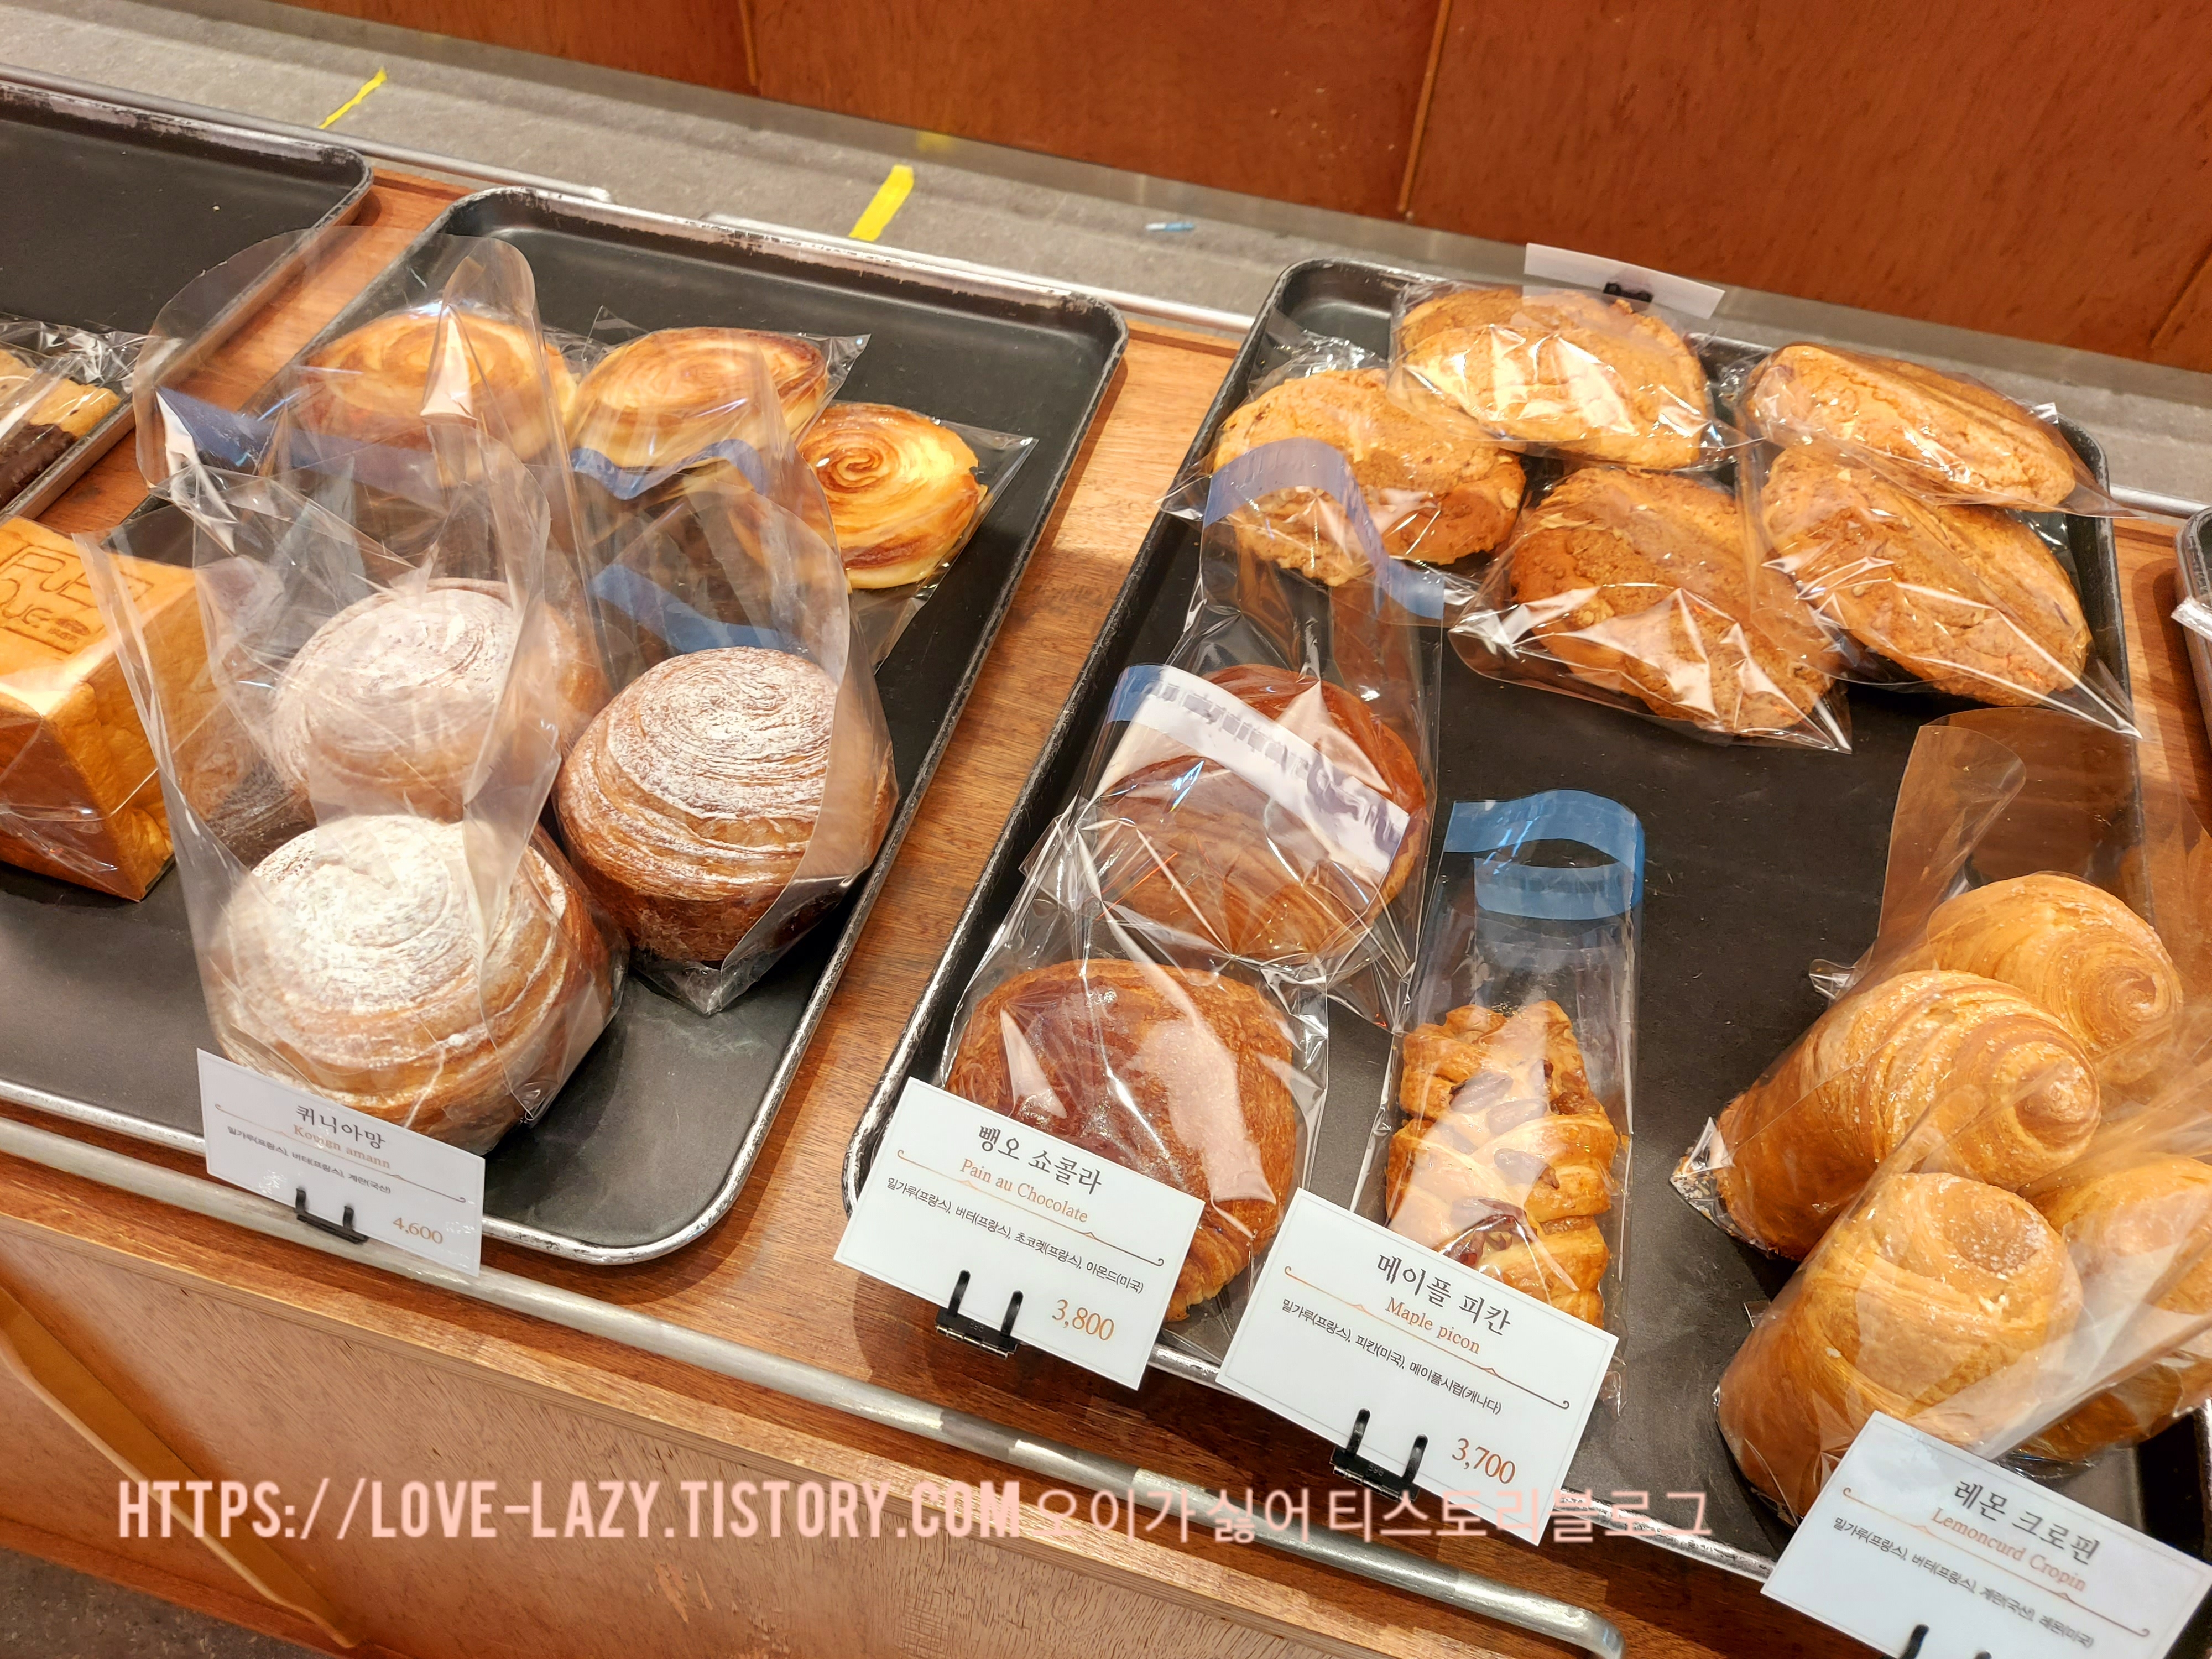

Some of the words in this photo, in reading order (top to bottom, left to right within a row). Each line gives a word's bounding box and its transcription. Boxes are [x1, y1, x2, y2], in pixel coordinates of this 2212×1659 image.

[296, 1105, 386, 1149] 퀴니아망
[346, 1147, 390, 1169] amann
[978, 1125, 1020, 1160] 뺑오
[1028, 1150, 1102, 1195] 쇼콜라
[960, 1158, 992, 1183] Pain
[995, 1177, 1013, 1192] au
[1018, 1183, 1088, 1223] Chocolate
[393, 1217, 444, 1245] 4,600
[1086, 1261, 1144, 1295] 아몬드(미국)
[1377, 1254, 1452, 1308] 메이플
[1459, 1295, 1511, 1335] 피칸
[1052, 1298, 1115, 1342] 3,800
[1385, 1297, 1433, 1330] Maple
[1436, 1326, 1480, 1354] picon
[1410, 1361, 1501, 1415] 메이플시럽(캐나다)
[1451, 1437, 1516, 1485] 3,700
[1931, 1507, 2027, 1561] Lemoncurd
[2030, 1554, 2086, 1592] Cropin
[1954, 1481, 2008, 1521] 레몬
[2012, 1510, 2100, 1566] 크로핀
